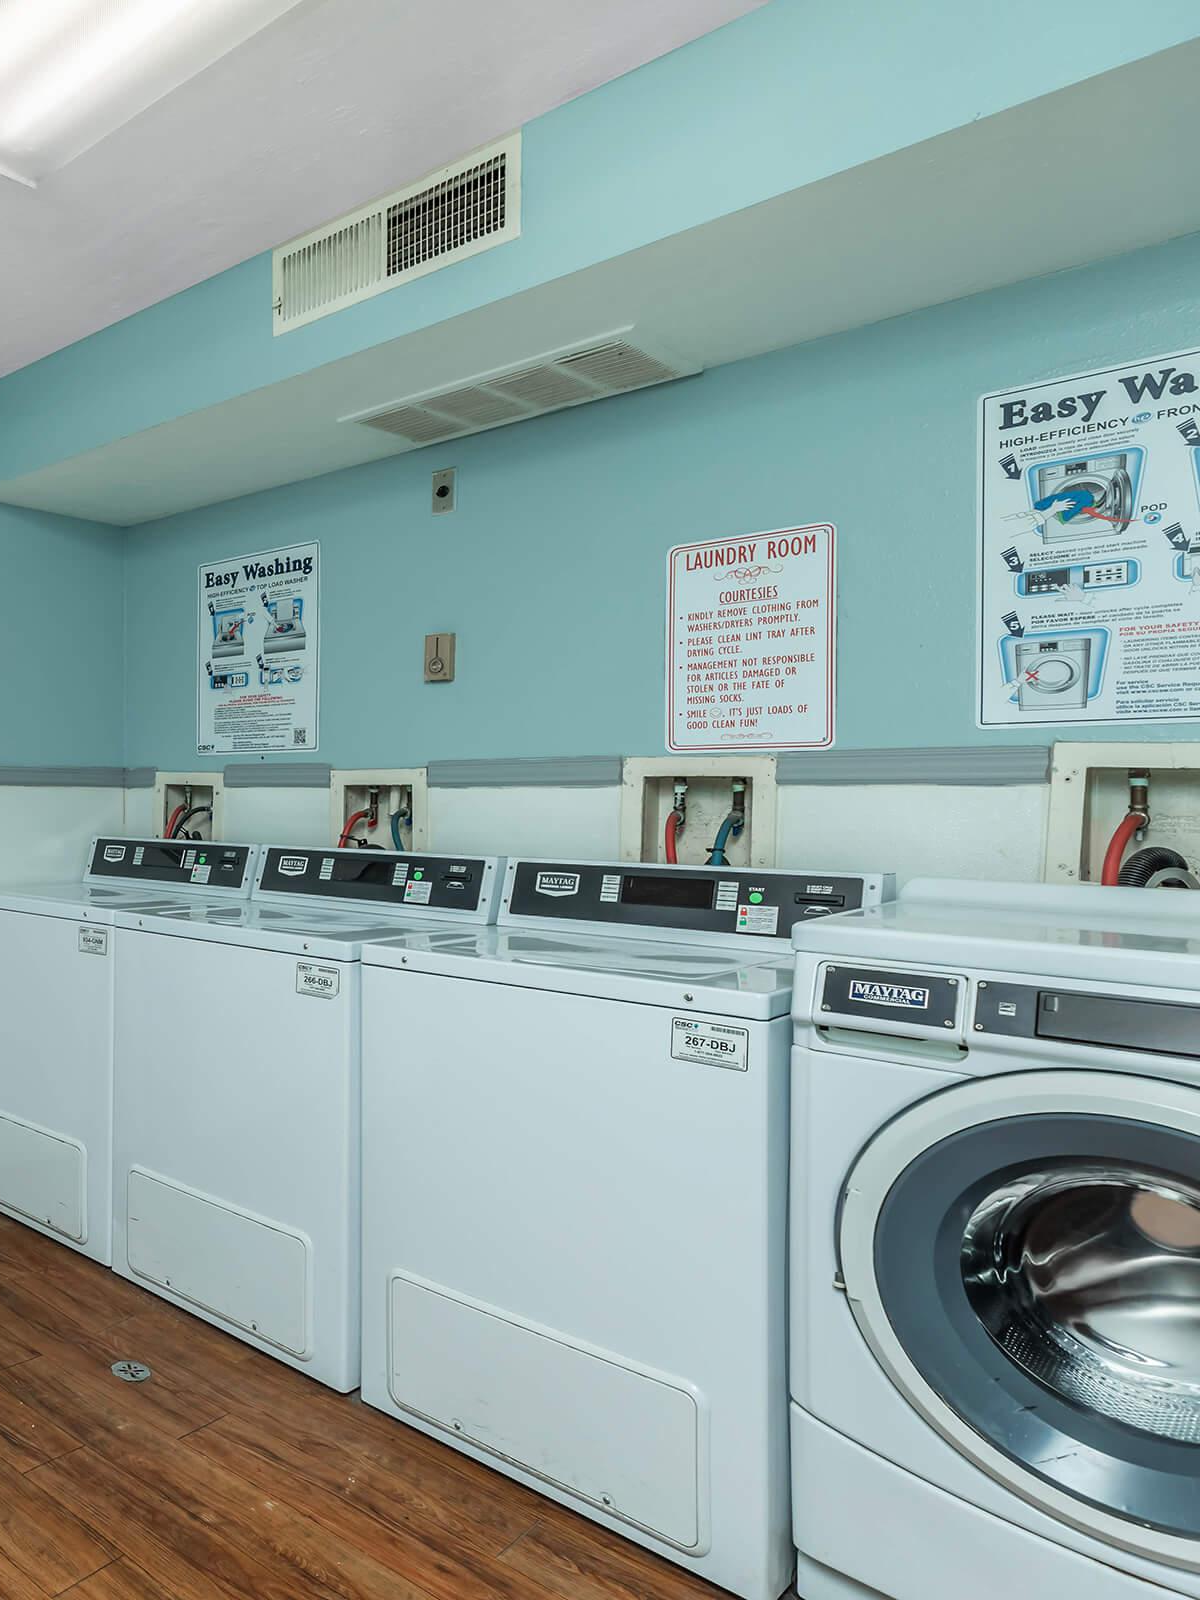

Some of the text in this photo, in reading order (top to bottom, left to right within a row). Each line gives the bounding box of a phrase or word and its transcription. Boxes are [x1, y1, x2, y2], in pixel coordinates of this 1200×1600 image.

[999, 368, 1199, 430] Easy Wa
[999, 417, 1129, 449] HIGH-EFFICIENCY
[1141, 503, 1167, 513] POD
[686, 534, 816, 571] LAUNDRY ROOM
[1009, 557, 1018, 566] 3
[205, 556, 312, 589] Easy Washing
[285, 576, 308, 584] WASHER
[719, 585, 778, 603] COURTESIES
[688, 599, 819, 621] KINDLY REMOVE CLOTHING FROM
[688, 614, 800, 633] WASHERS/DRYERS PROMPTLY.
[1010, 622, 1019, 630] 5
[688, 626, 816, 646] PLEASE CLEAN LINT TRAY AFTER
[688, 645, 742, 657] DRYING CYCLE.
[688, 660, 737, 671] MANAGEMENT
[762, 653, 815, 665] RESPONSIBLE
[688, 667, 796, 682] FOR ARTICLES DAMAGED OR
[687, 679, 785, 693] STOLEN OR THE FATE OF
[687, 695, 744, 704] MISSING SOCKS.
[687, 705, 808, 718] SMILE IT'S JUST LOADS OF
[687, 719, 758, 729] GOOD CLEAN FUN!
[542, 877, 574, 885] MAYTAG
[855, 983, 924, 1001] MAYTAG
[864, 994, 910, 1004] COMMERCIAL
[685, 1036, 735, 1052] 267-DBJ
